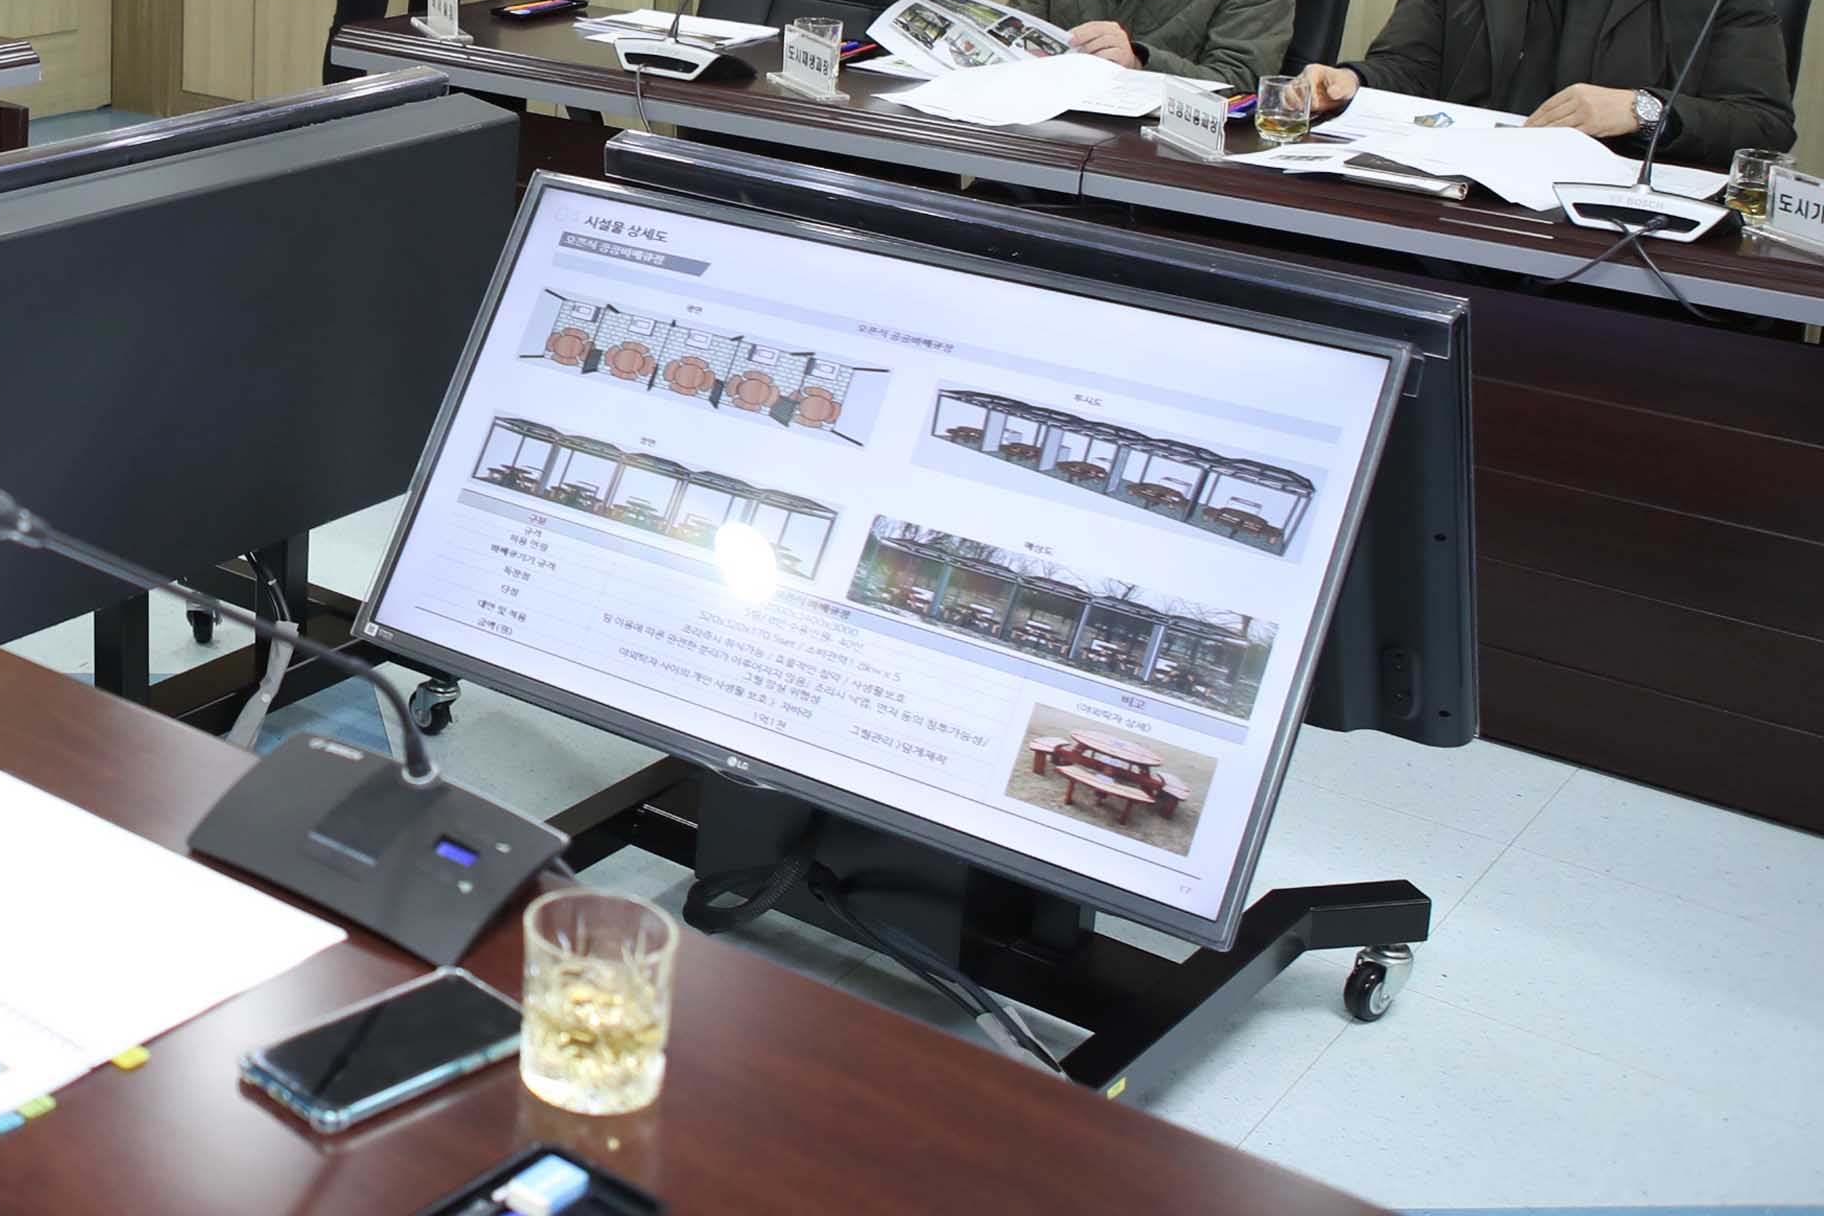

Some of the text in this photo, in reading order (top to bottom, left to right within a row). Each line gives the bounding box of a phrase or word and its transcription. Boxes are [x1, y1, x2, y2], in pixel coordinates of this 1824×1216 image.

[584, 215, 625, 234] 시설물
[627, 224, 669, 242] 상세도
[736, 759, 750, 771] LG
